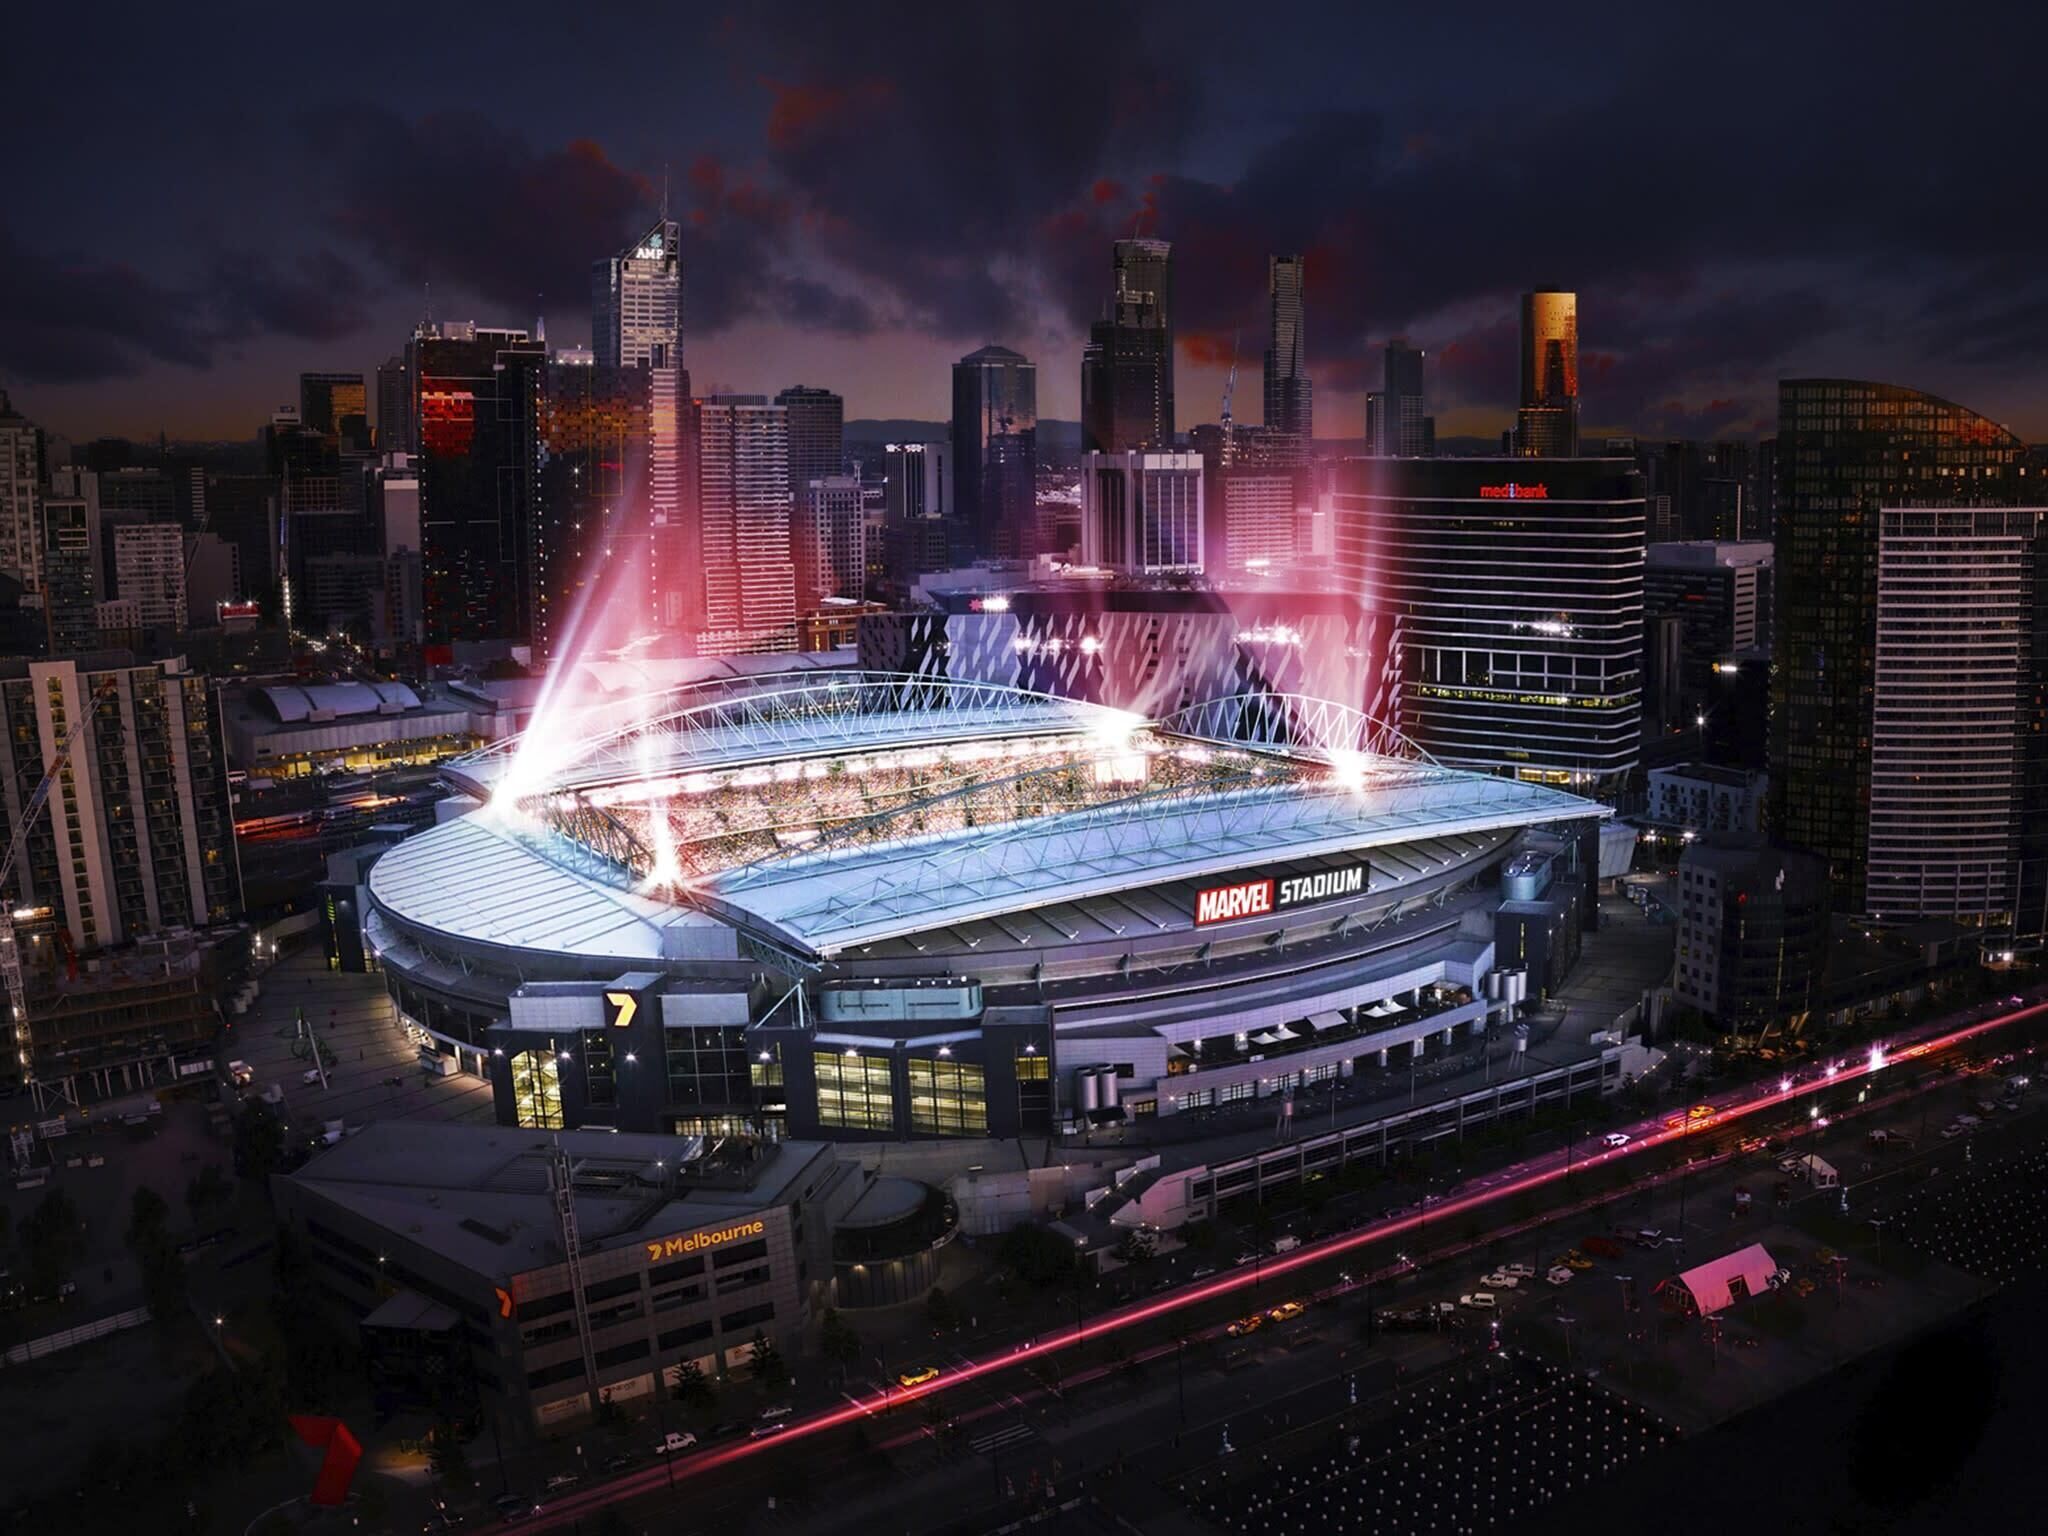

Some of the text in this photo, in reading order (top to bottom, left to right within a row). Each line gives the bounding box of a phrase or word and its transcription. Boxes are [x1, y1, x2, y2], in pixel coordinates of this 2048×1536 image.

[636, 247, 664, 259] AMP
[1480, 483, 1548, 498] medibank
[1198, 867, 1362, 922] MARVEL STADIUM
[606, 993, 637, 1026] 7
[665, 1221, 764, 1257] Melbourne
